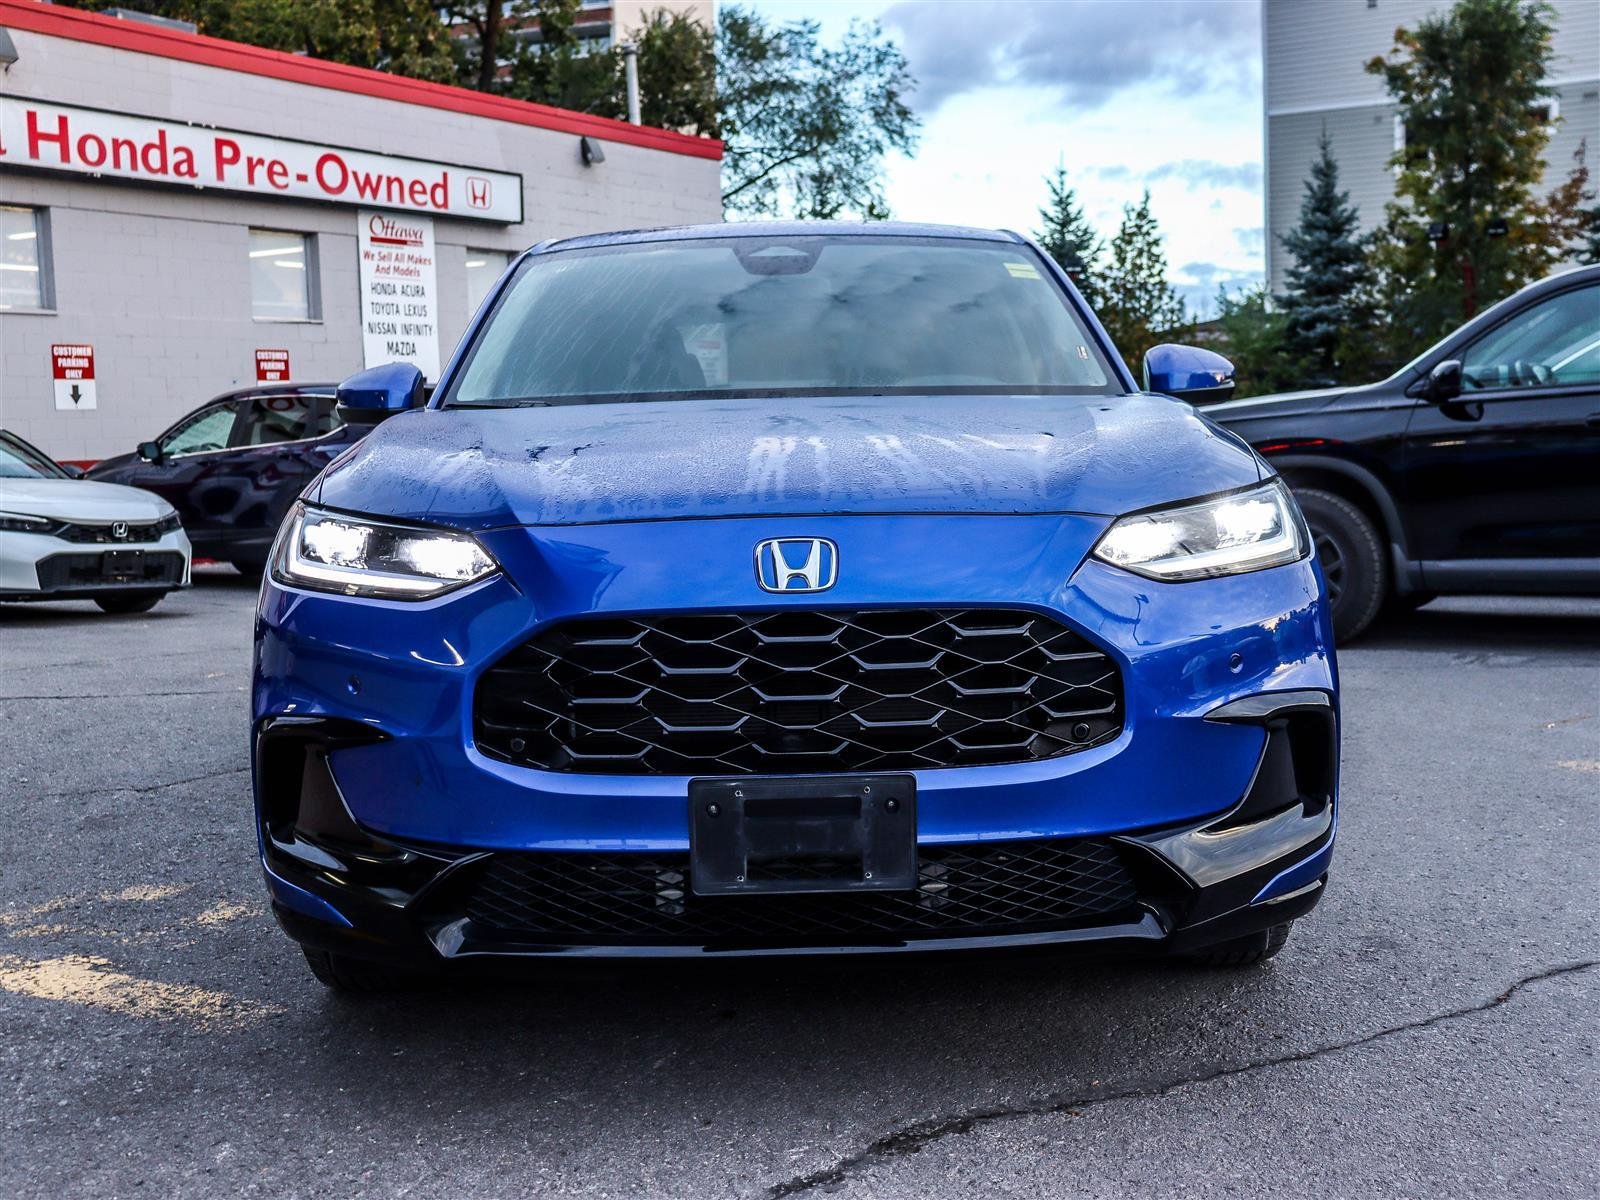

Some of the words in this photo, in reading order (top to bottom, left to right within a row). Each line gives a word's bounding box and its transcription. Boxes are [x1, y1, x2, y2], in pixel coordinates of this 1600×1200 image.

[26, 110, 198, 179] Honda
[214, 137, 449, 210] Pre-Owned
[369, 214, 423, 239] Ottawa
[363, 250, 375, 261] We
[378, 251, 392, 263] Sell
[395, 252, 405, 264] All
[407, 253, 432, 266] Makes
[375, 264, 390, 276] And
[393, 265, 421, 278] Models
[371, 283, 397, 296] HONDA
[401, 284, 426, 298] ACURA
[371, 302, 400, 316] TOYOTA
[404, 304, 428, 318] LEXUS
[368, 322, 397, 335] NISSAN
[401, 323, 433, 337] INFINITY
[53, 346, 92, 356] CUSTOMER
[386, 342, 417, 356] MAZDA
[58, 357, 89, 368] PARKING
[65, 369, 82, 379] ONLY
